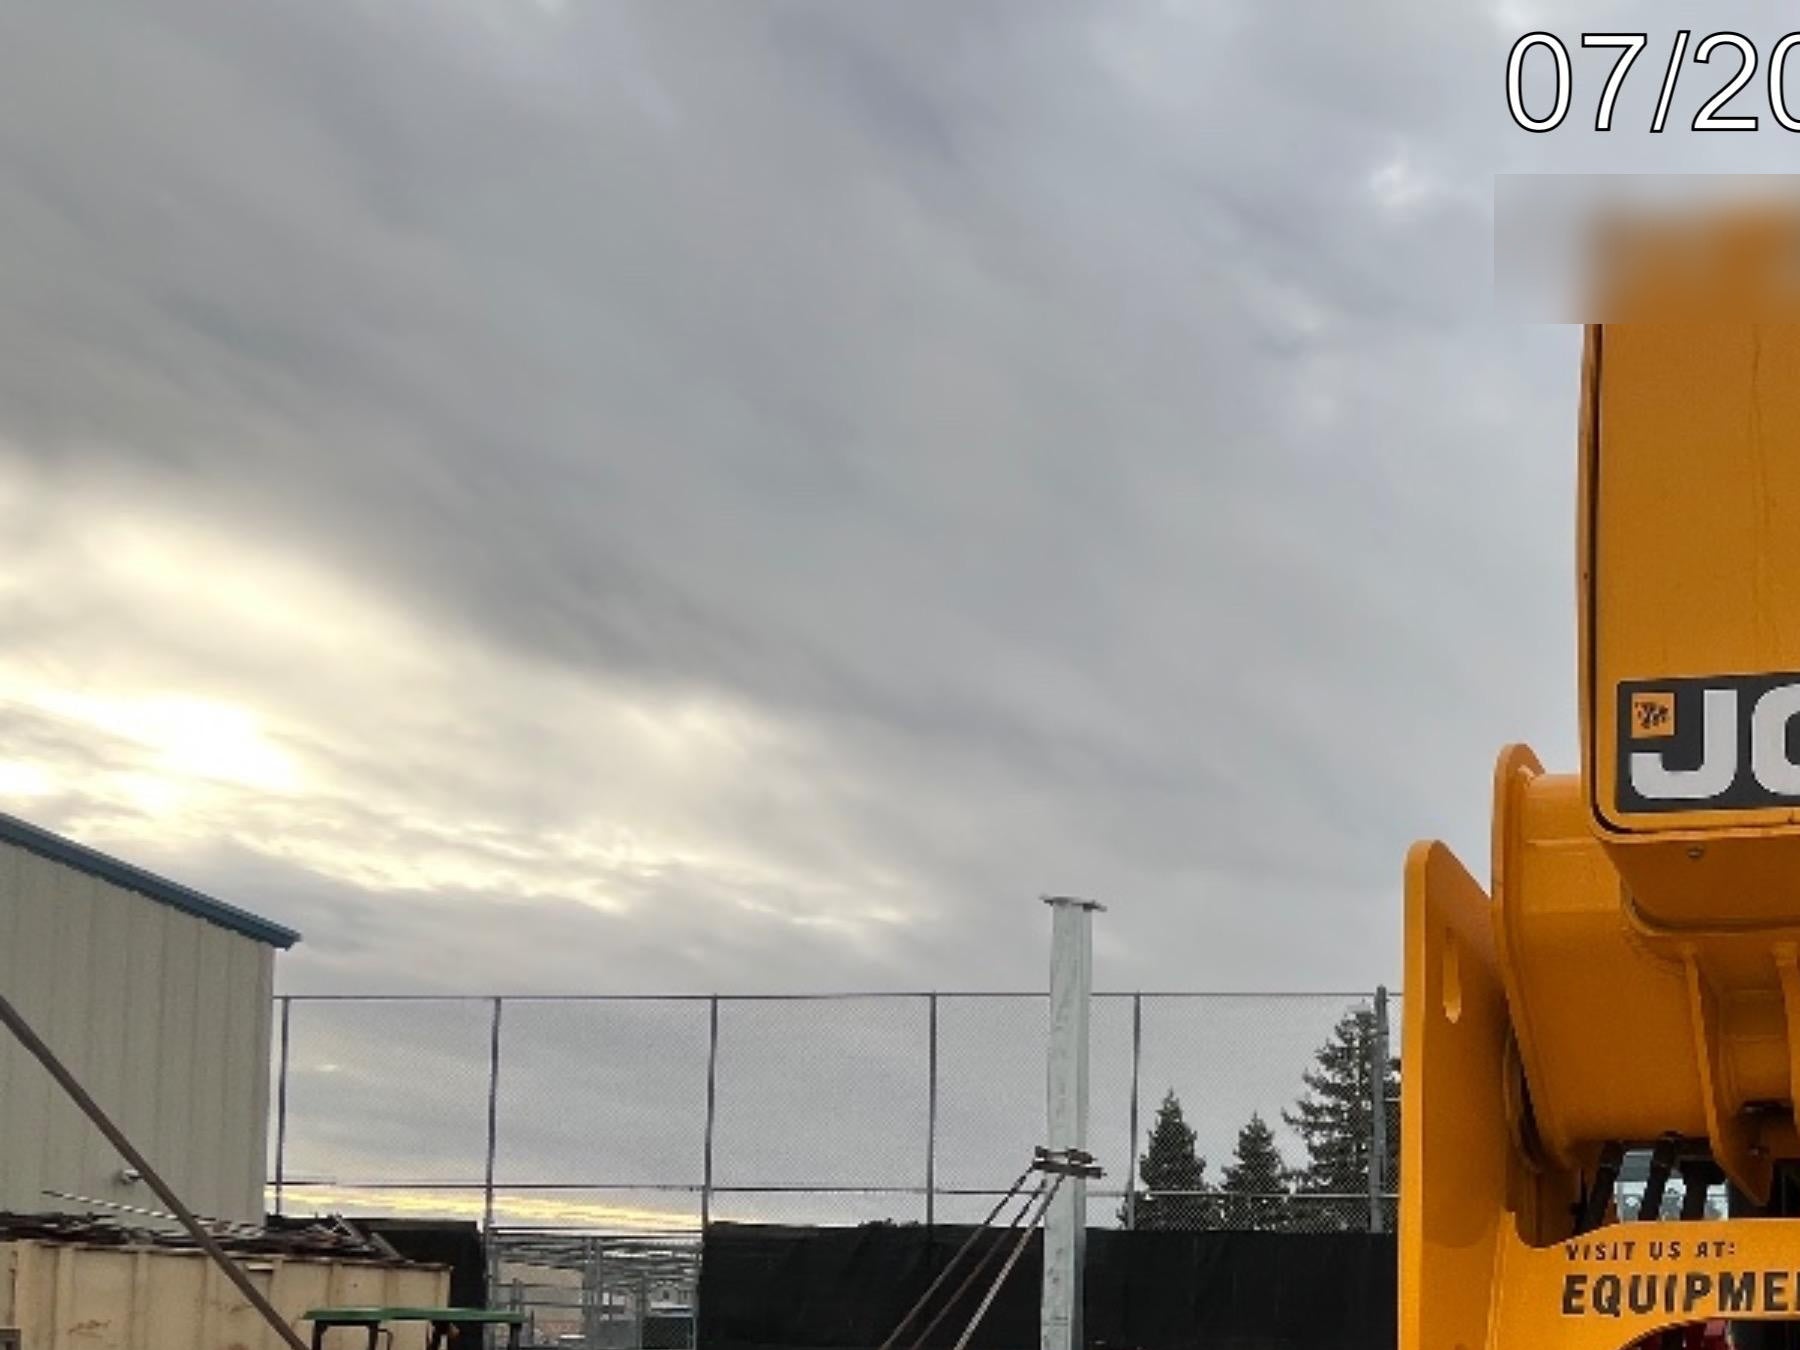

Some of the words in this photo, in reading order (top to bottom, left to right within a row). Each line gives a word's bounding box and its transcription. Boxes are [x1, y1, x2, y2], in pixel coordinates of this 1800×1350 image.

[1565, 1241, 1636, 1261] VISIT
[1649, 1240, 1683, 1260] US
[1695, 1240, 1736, 1259] AT:
